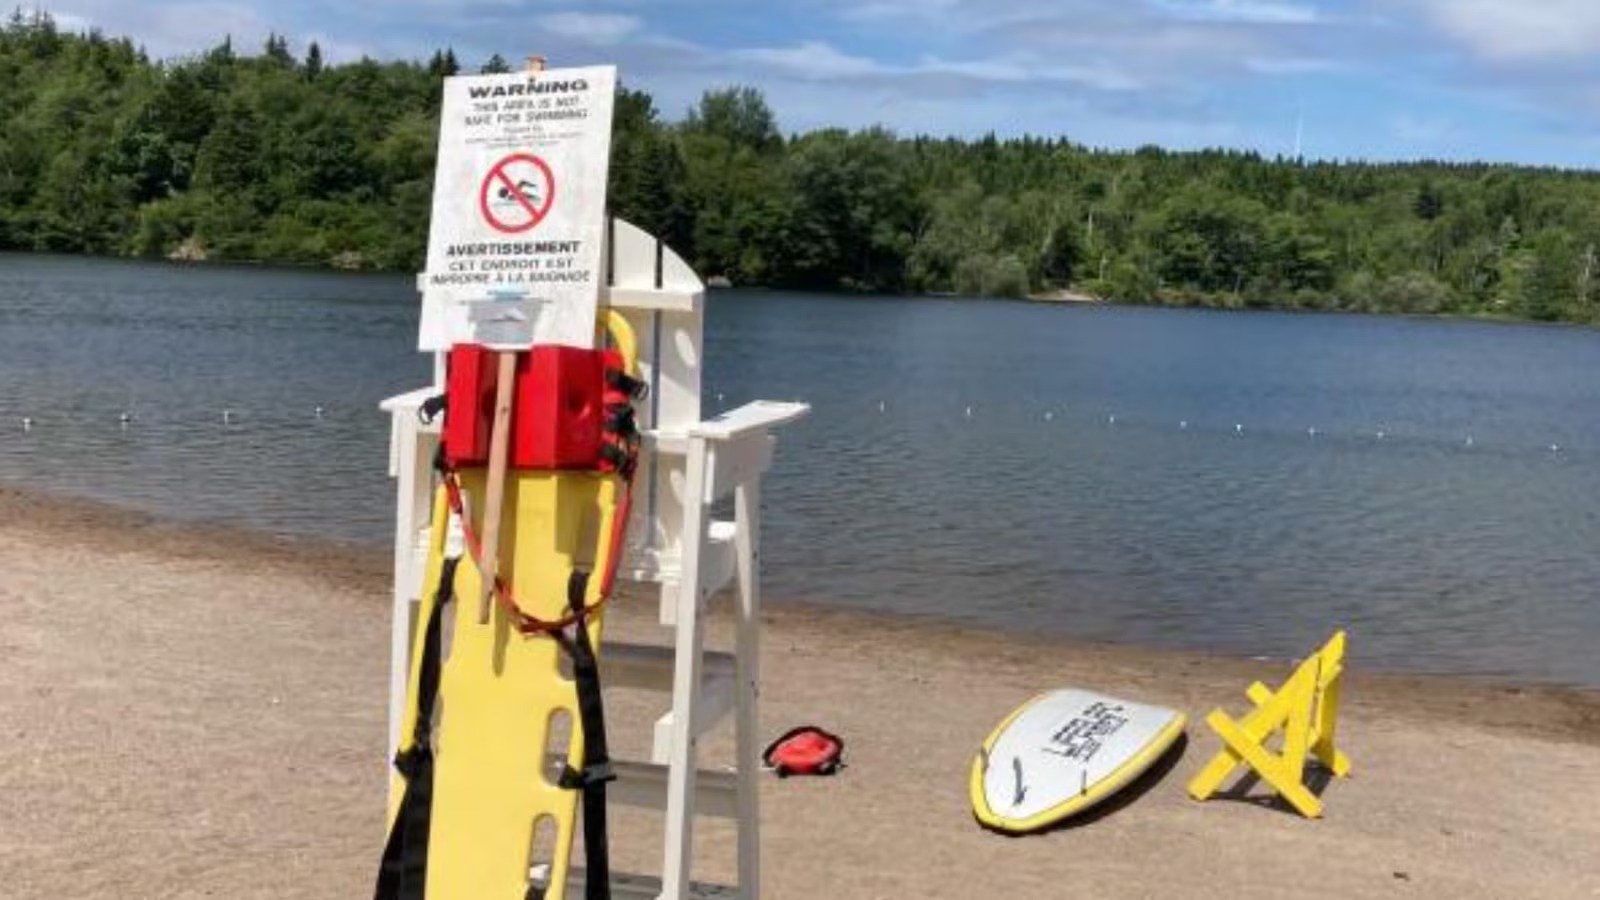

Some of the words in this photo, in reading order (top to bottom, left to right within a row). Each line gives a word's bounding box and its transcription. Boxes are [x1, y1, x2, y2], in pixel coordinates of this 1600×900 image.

[468, 78, 589, 98] WARNING
[503, 99, 535, 111] AREA
[539, 98, 551, 108] IS
[497, 112, 520, 123] FOR
[446, 240, 581, 256] AVERTISSEMENT
[449, 260, 475, 271] CET
[481, 258, 541, 270] ENDROIT
[546, 257, 574, 269] EST
[508, 271, 524, 283] LA
